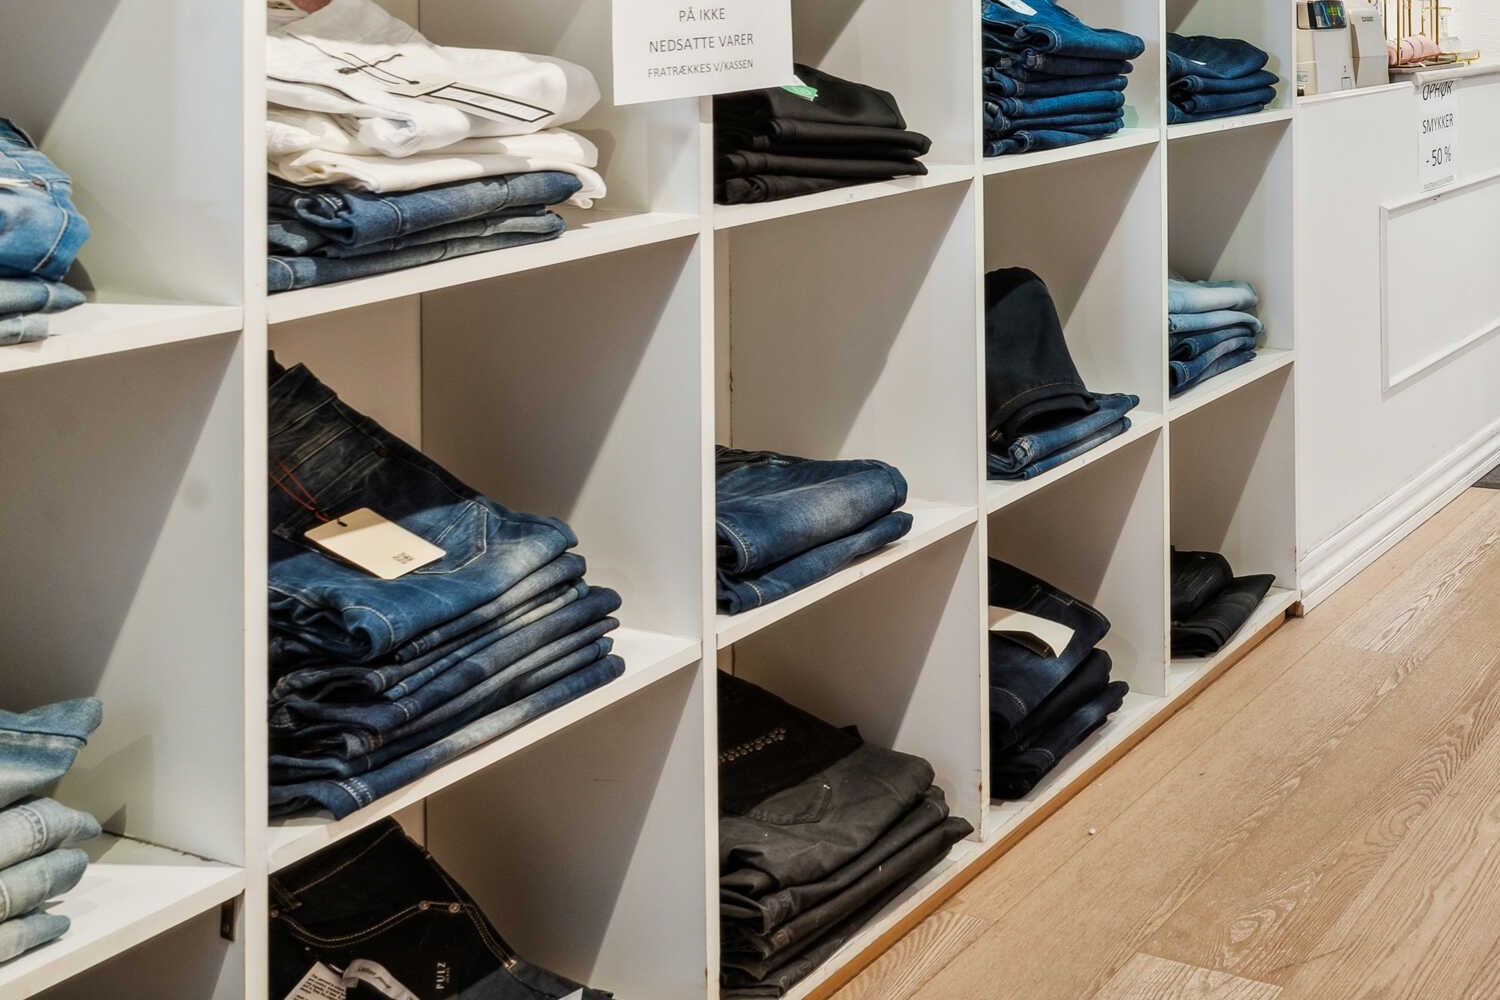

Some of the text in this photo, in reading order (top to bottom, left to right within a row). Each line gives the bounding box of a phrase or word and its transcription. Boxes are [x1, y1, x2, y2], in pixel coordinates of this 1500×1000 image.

[679, 6, 726, 22] PÅ IKKE
[649, 33, 754, 53] NEDSATTE VARER
[647, 59, 753, 78] FRATRÆKKES V/KASSEN
[1422, 113, 1454, 135] SMYKKER
